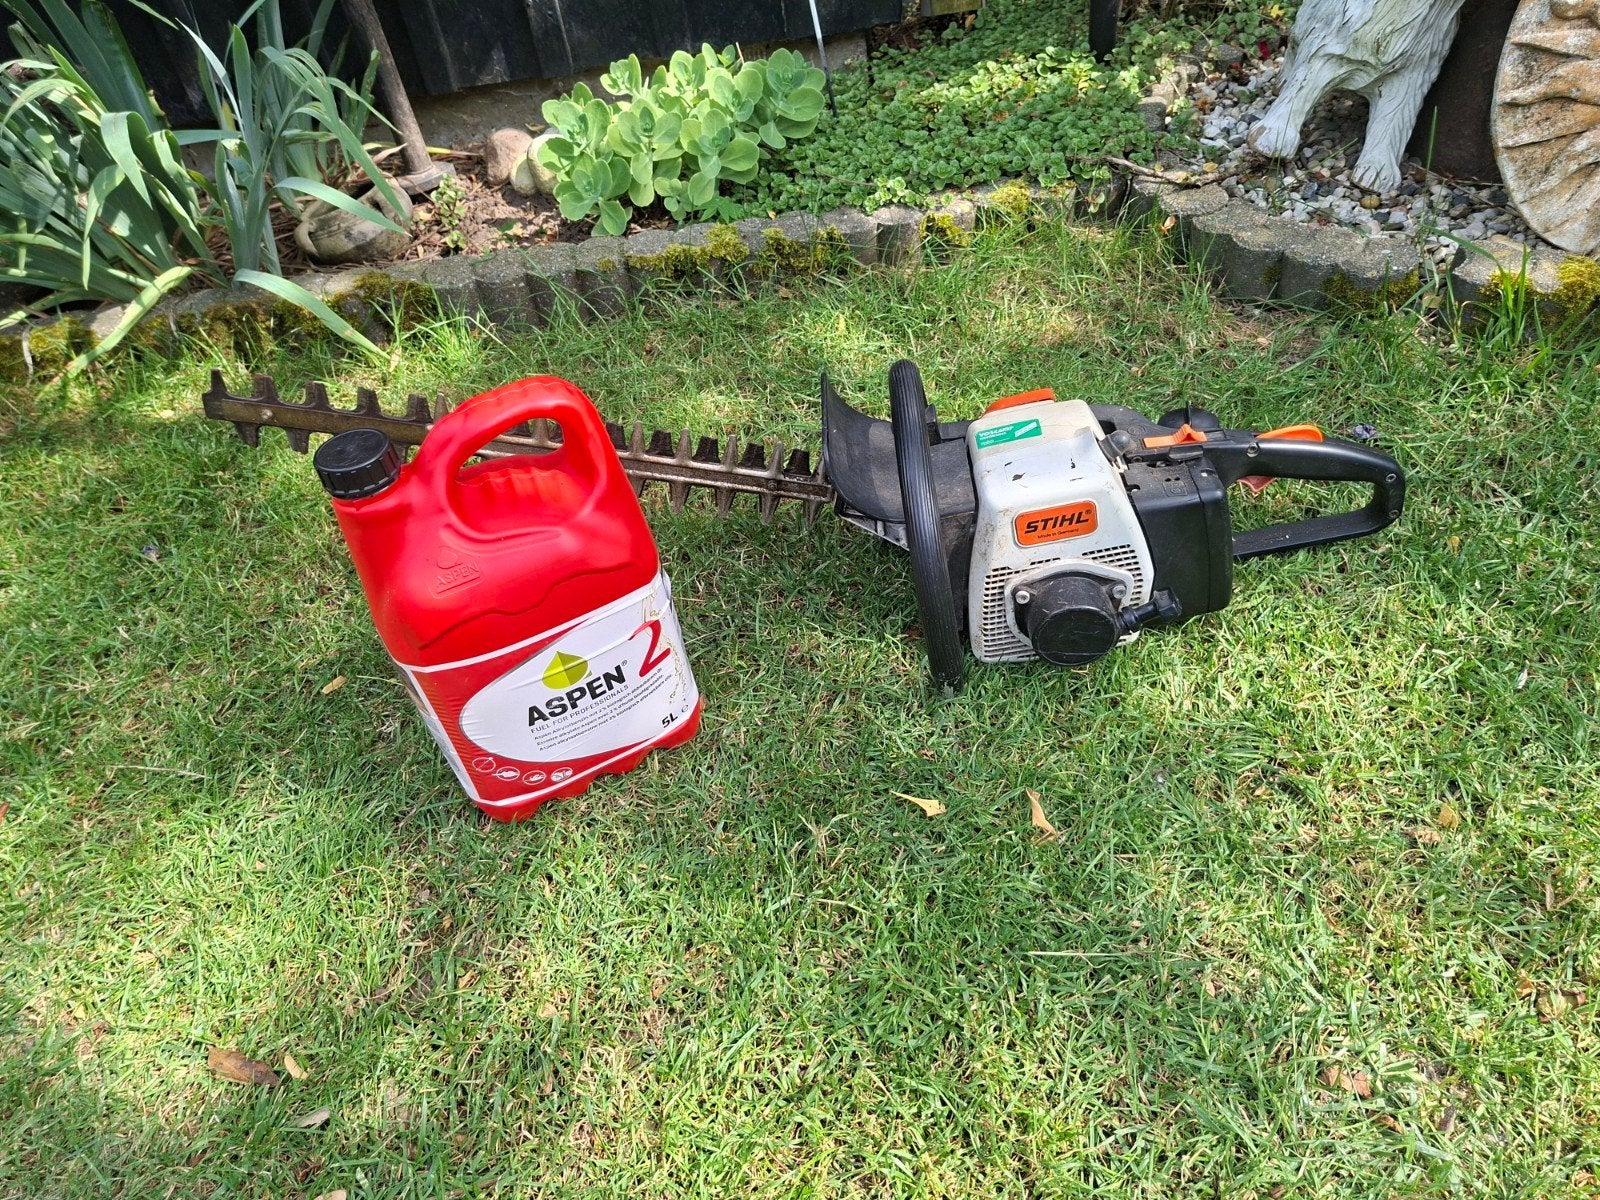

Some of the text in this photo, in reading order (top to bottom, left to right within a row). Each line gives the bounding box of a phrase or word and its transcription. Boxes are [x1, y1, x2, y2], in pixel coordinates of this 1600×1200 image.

[1057, 528, 1079, 536] Germany
[435, 560, 479, 588] ASPEN
[628, 619, 671, 677] 2
[530, 684, 629, 733] FUEL FOR PROFESSIONALS
[662, 712, 679, 728] 5L
[535, 731, 552, 740] Aspen
[540, 742, 557, 751] Aspen
[598, 718, 608, 726] met
